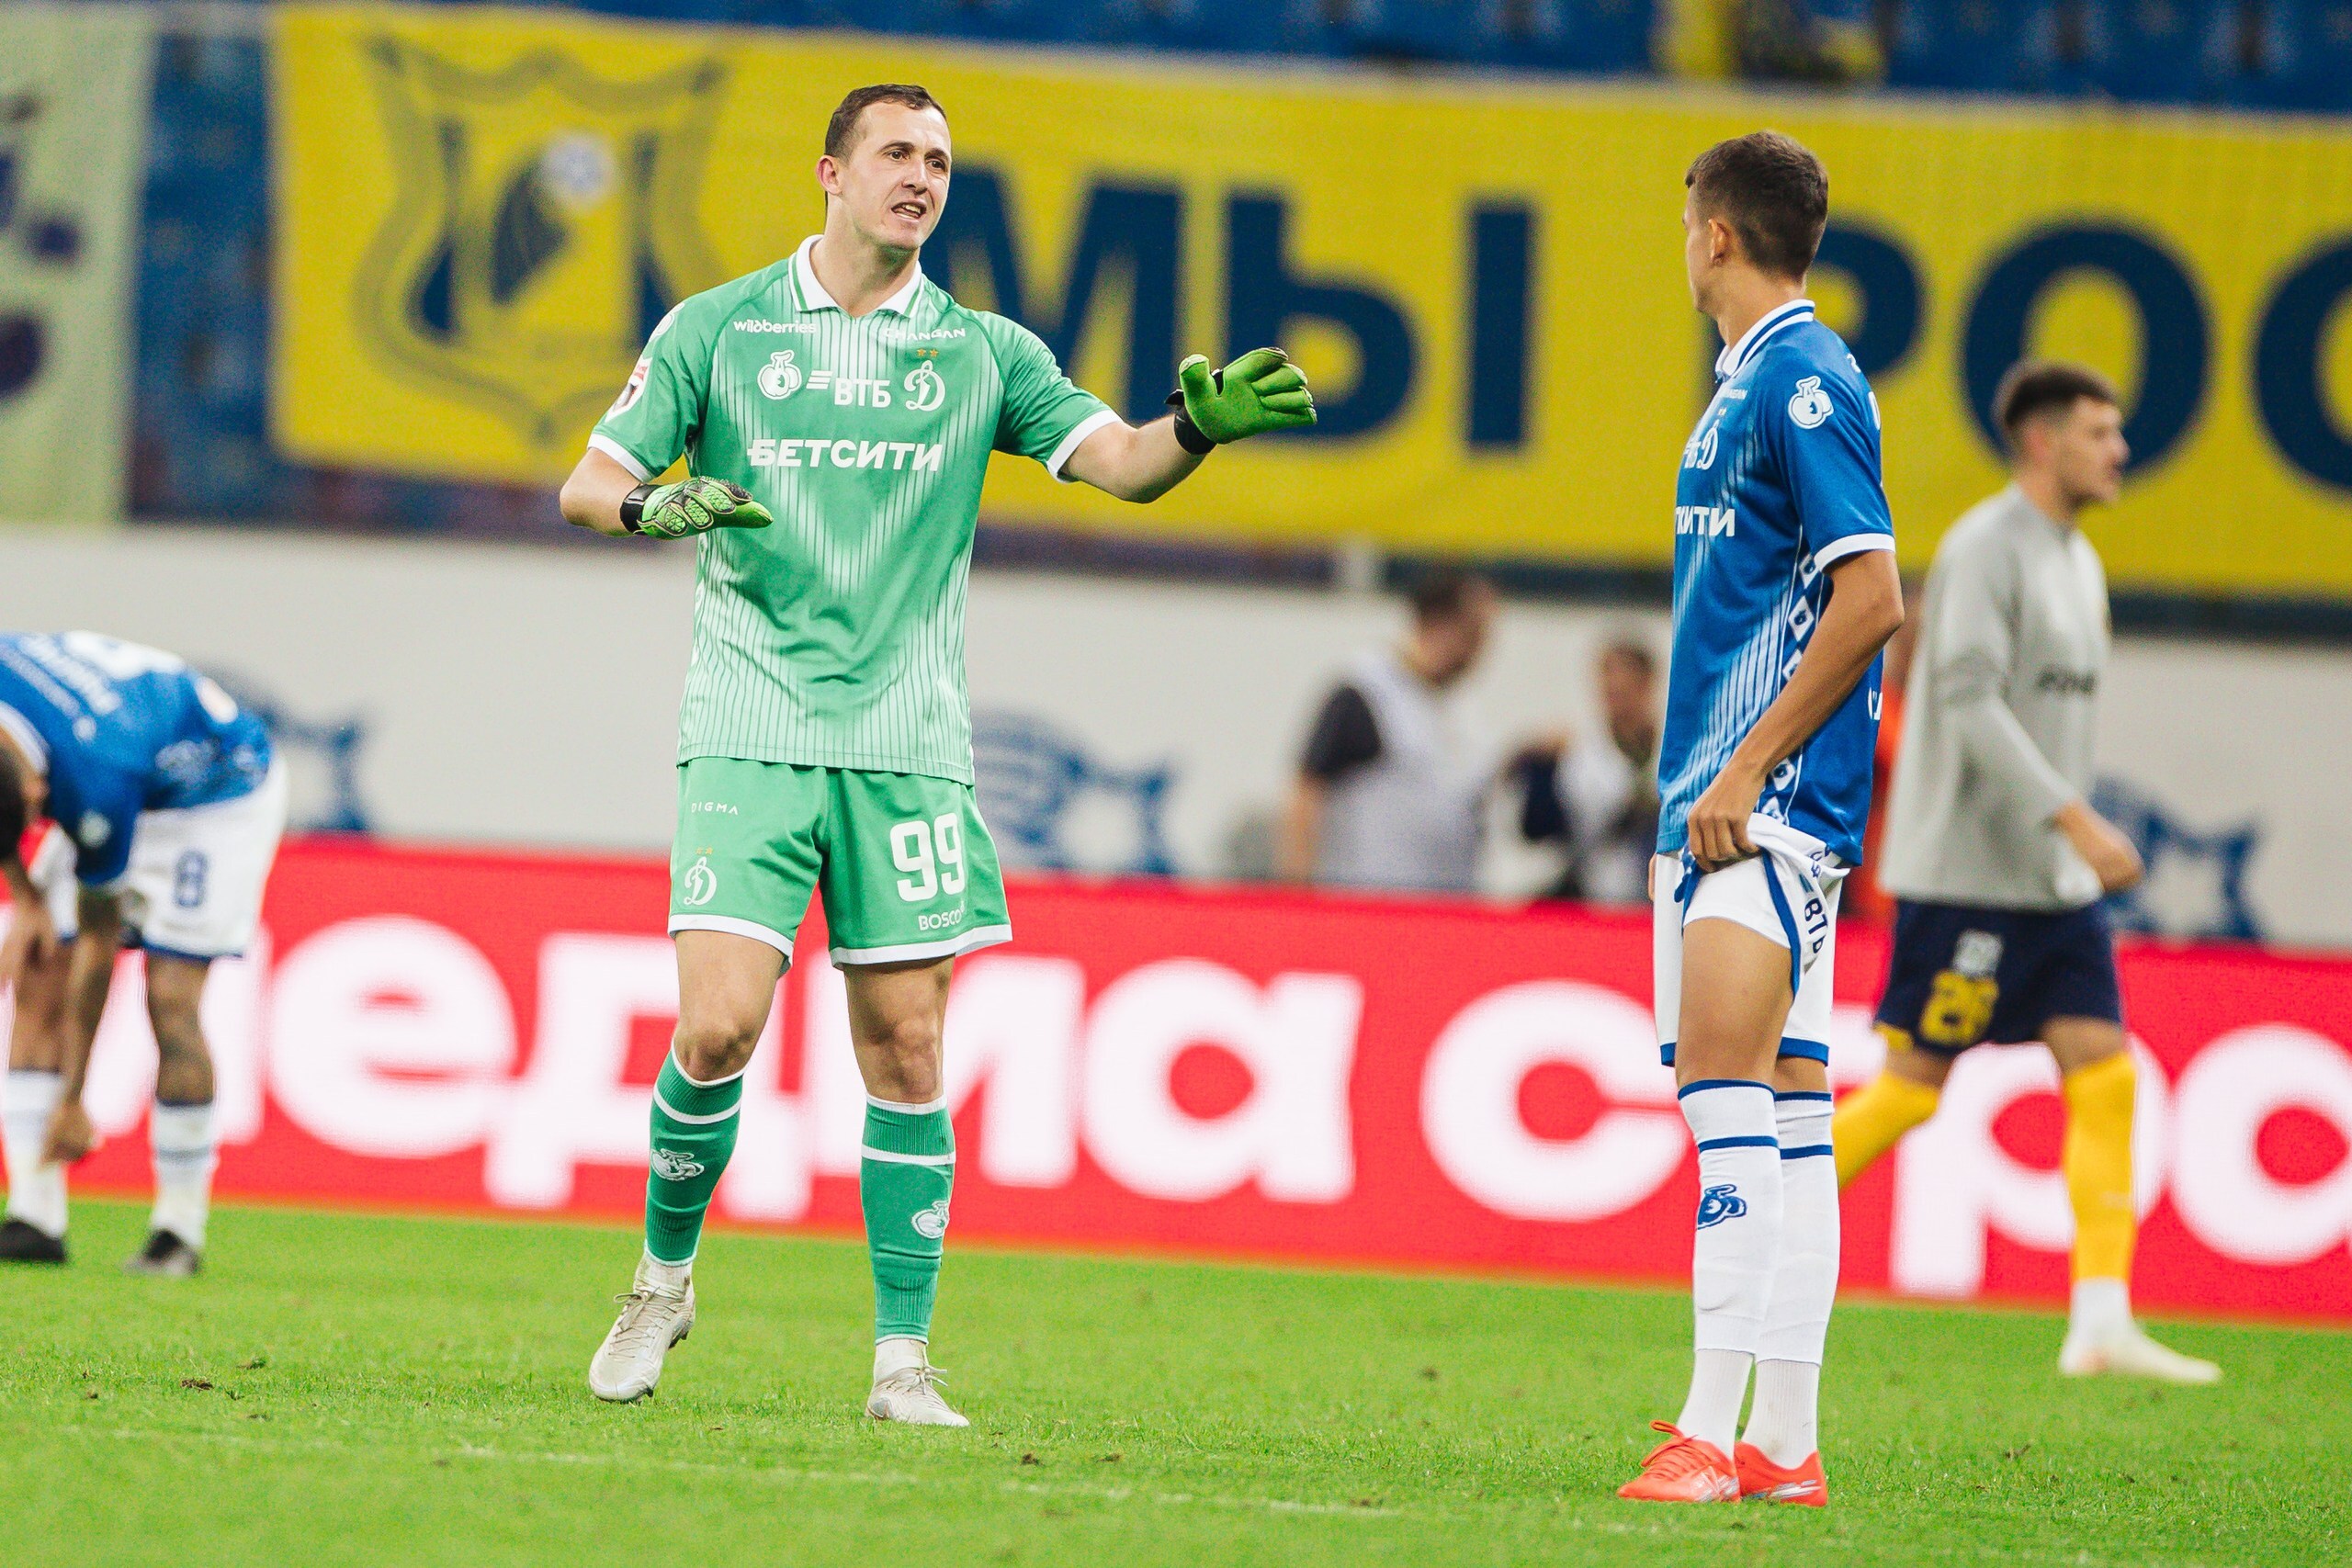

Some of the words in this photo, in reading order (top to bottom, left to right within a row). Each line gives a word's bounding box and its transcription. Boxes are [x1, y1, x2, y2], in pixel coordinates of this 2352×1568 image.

[915, 158, 1532, 450] МЫ
[732, 318, 818, 334] wildberries
[879, 327, 967, 342] CHANGAN
[833, 377, 892, 409] ВТБ
[747, 439, 943, 471] БЕТСИТИ
[1675, 506, 1736, 537] ИТИ
[691, 801, 739, 816] DIGMA
[889, 812, 967, 902] 99
[174, 851, 209, 908] 8
[918, 908, 963, 931] BOSCO
[1420, 977, 2352, 1298] сра
